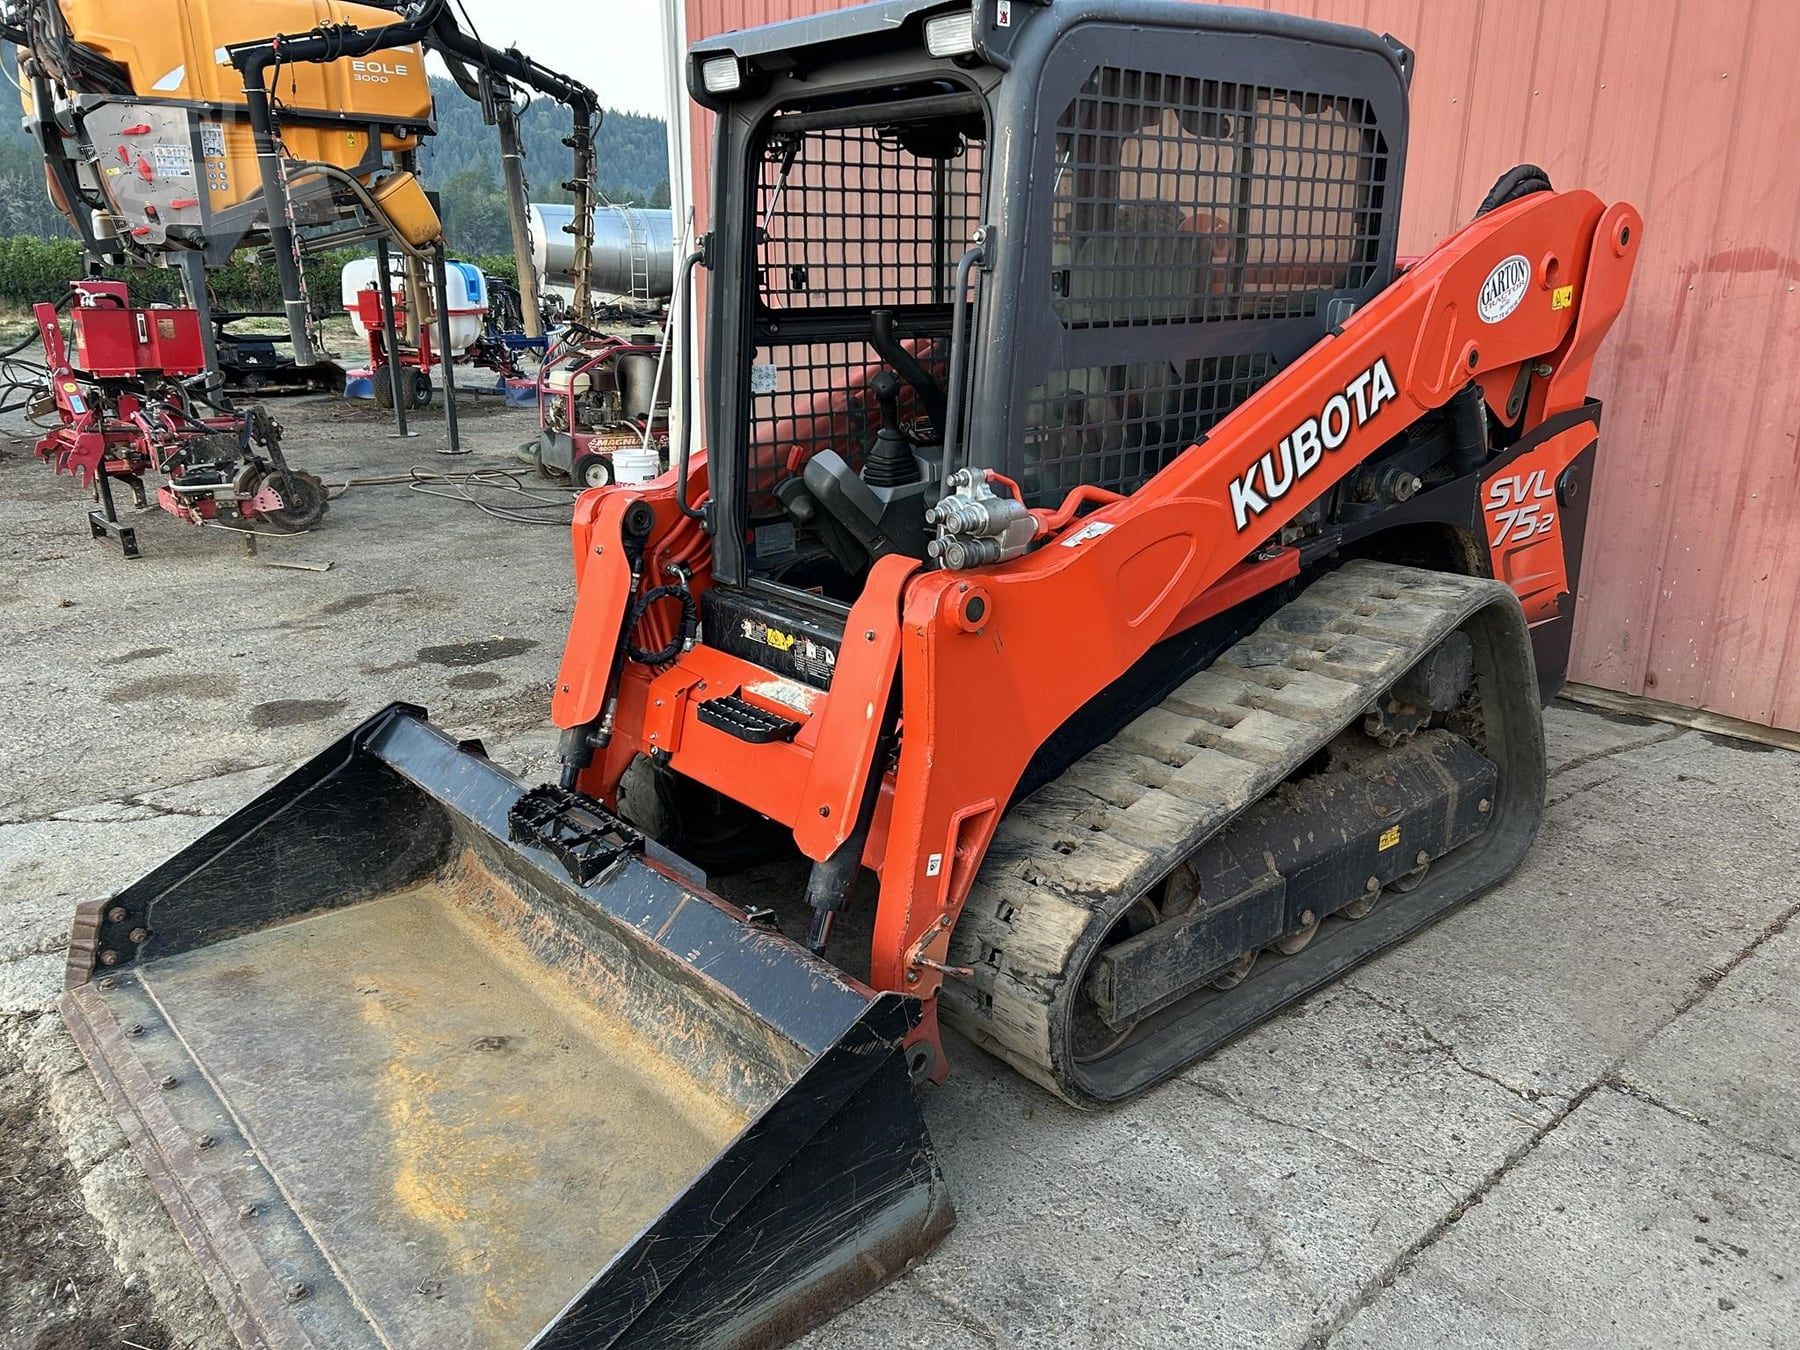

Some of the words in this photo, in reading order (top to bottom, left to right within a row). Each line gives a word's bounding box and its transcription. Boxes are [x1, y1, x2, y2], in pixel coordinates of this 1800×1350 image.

[352, 60, 408, 76] EOLE
[353, 73, 389, 83] 3000
[1481, 261, 1526, 306] GARTON
[1484, 279, 1526, 312] TRACTOR
[1228, 357, 1397, 532] KUBOTA
[1485, 469, 1554, 512] SVL
[1491, 503, 1555, 548] 75-2
